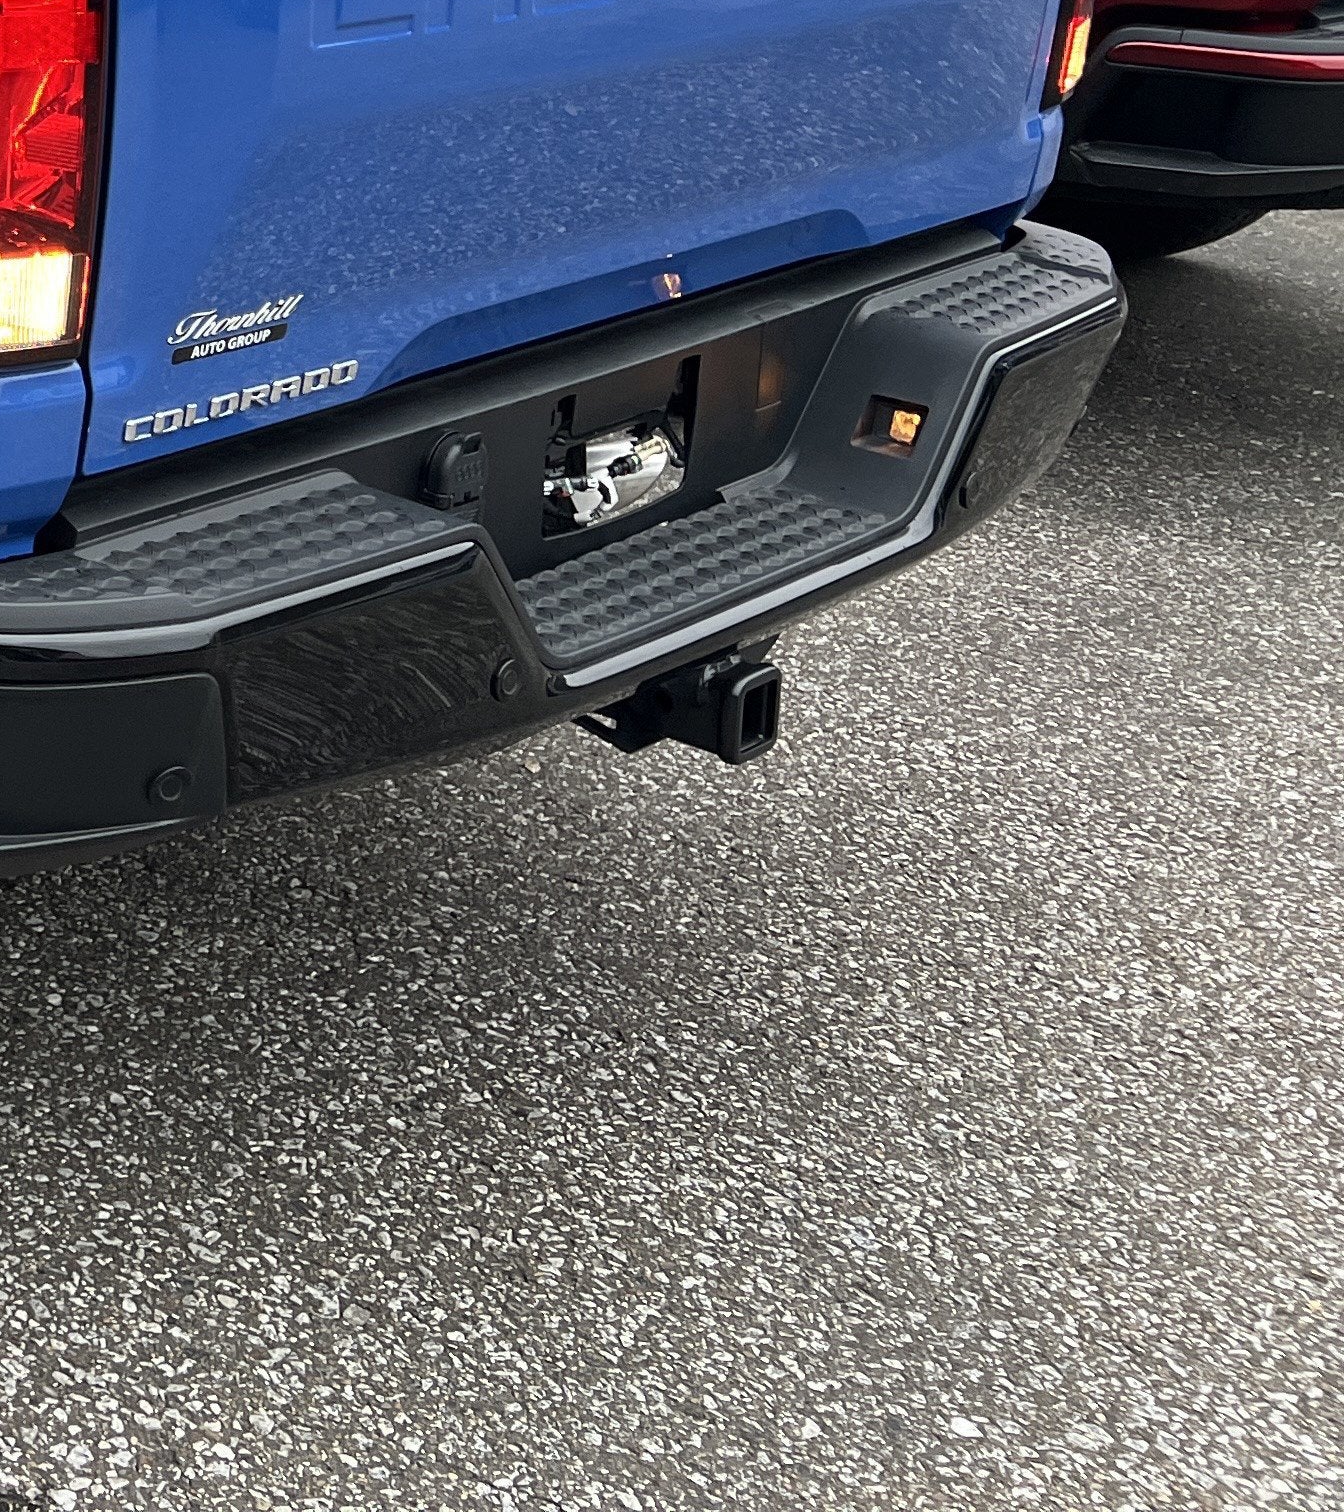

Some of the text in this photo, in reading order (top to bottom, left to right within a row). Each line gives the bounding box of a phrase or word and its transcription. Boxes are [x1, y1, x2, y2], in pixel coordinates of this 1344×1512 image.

[167, 293, 304, 345] Thornhill
[190, 328, 272, 360] AUTO GROUP
[124, 359, 359, 443] COLORADO
